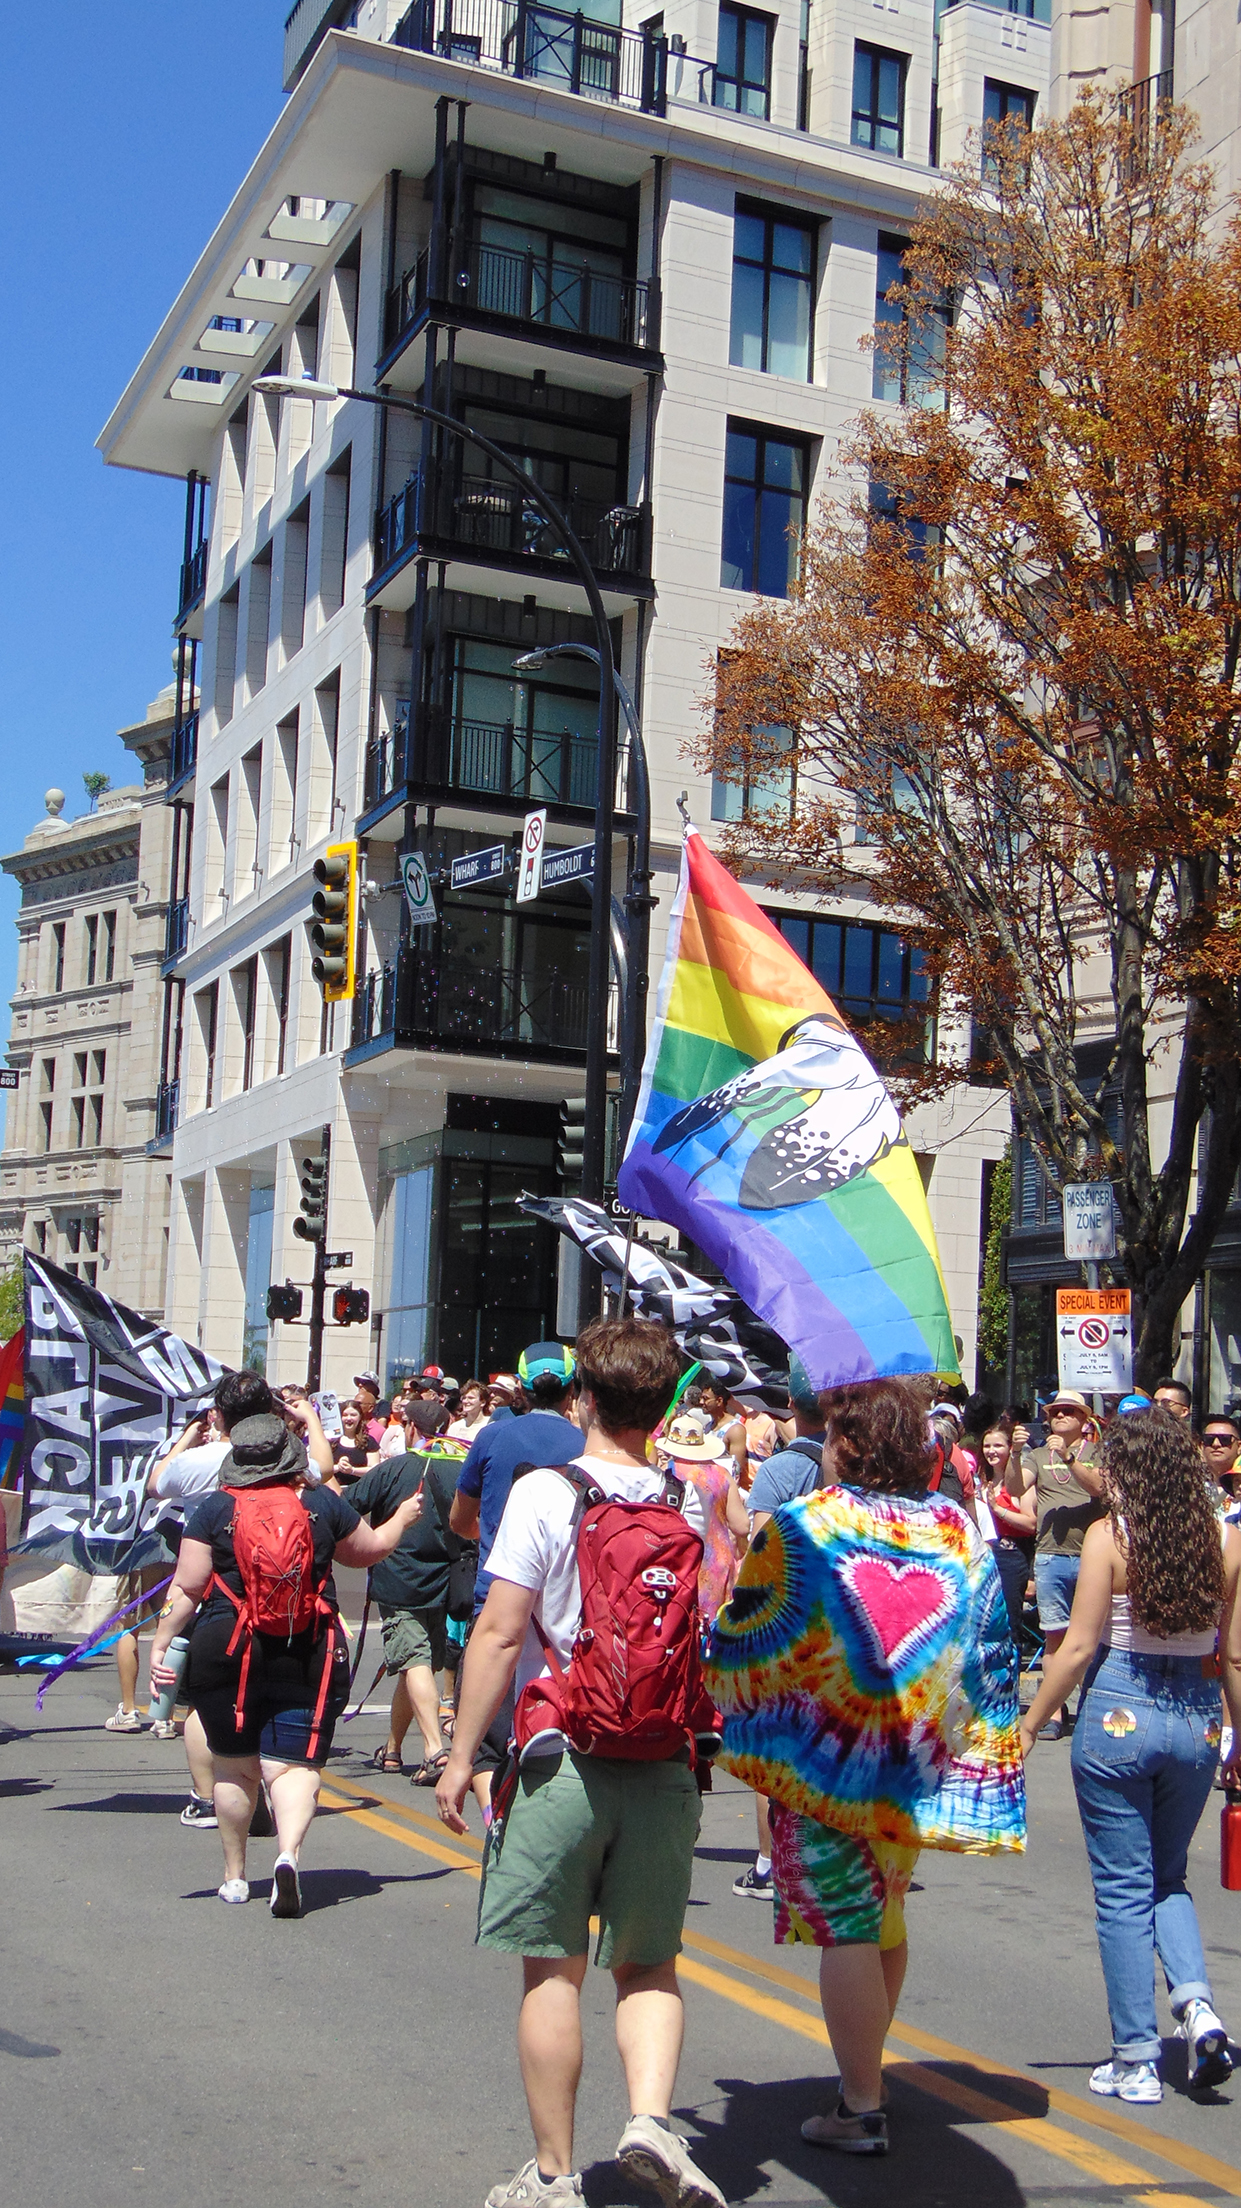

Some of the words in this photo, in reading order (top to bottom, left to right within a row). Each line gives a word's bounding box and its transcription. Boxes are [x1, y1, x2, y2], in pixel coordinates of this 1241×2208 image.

[455, 860, 479, 881] WHARF
[544, 854, 583, 880] HUMBOLDT
[1067, 1190, 1110, 1207] PASSENGER
[1076, 1213, 1101, 1229] ZONE
[1069, 1244, 1074, 1254] 3
[1060, 1295, 1096, 1310] SPECIAL
[1099, 1295, 1127, 1309] EVENT
